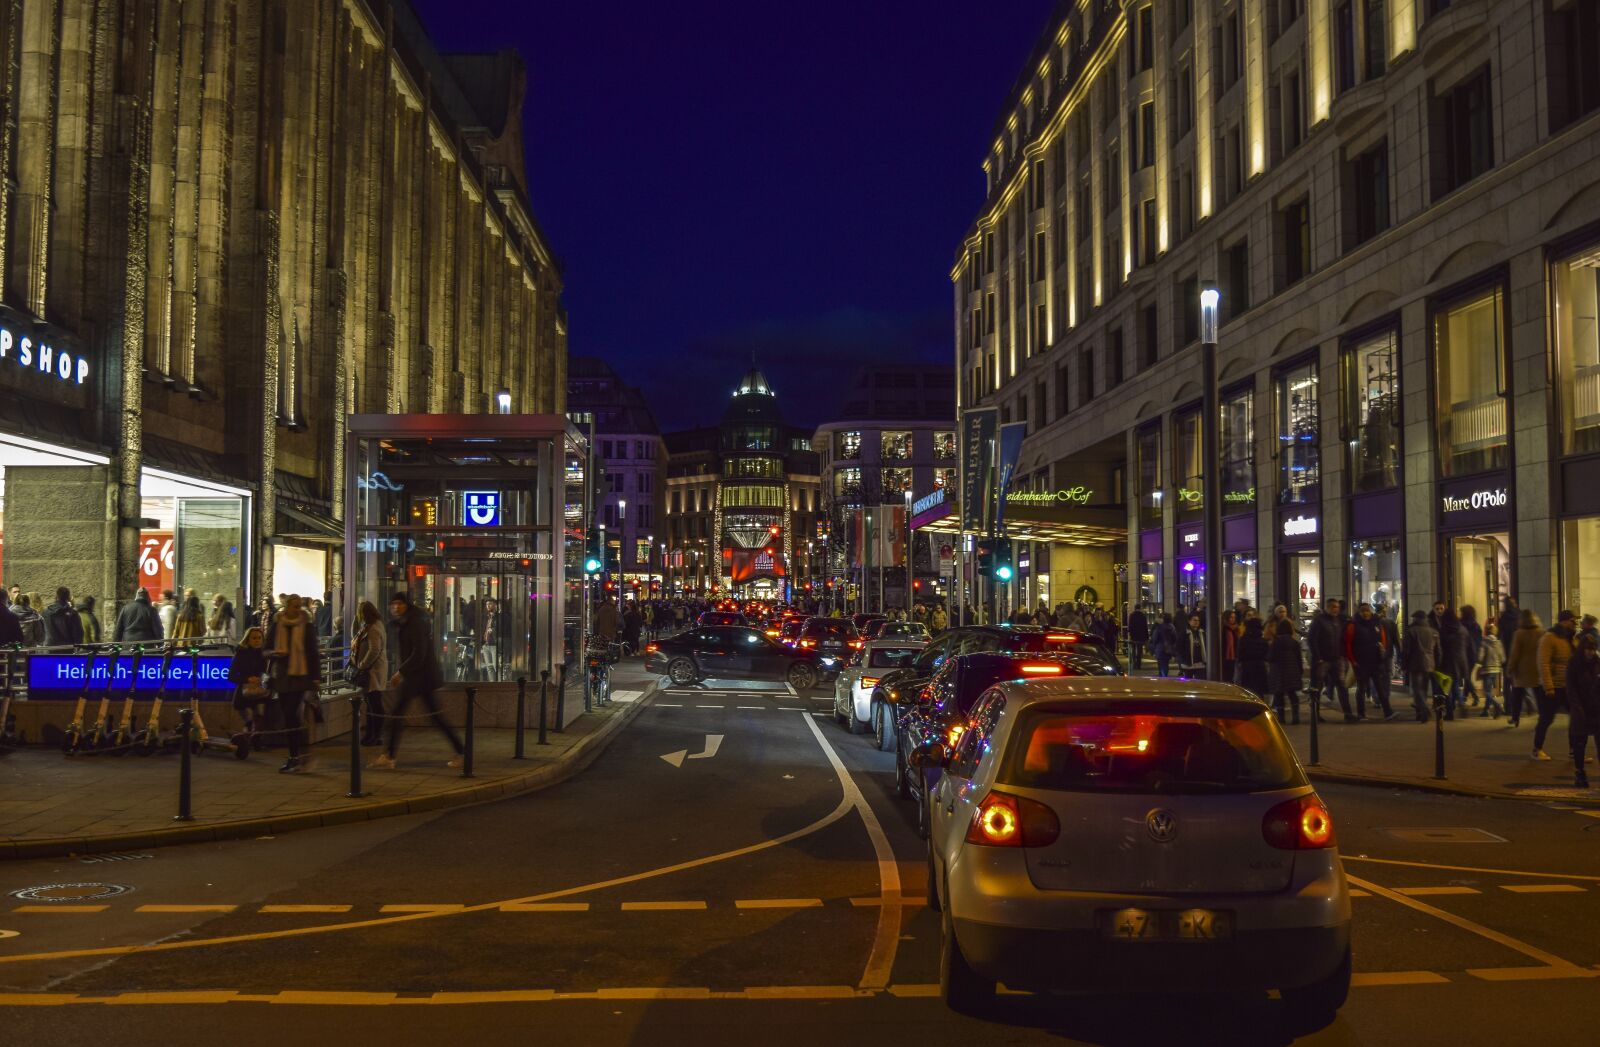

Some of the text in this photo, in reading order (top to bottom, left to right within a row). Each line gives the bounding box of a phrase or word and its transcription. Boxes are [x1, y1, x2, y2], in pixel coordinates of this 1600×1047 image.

[0, 329, 89, 384] PSHOP
[1057, 486, 1093, 504] Hof
[1443, 489, 1507, 512] Marc O'Polo
[57, 663, 230, 680] Heirih-Heie-Allee
